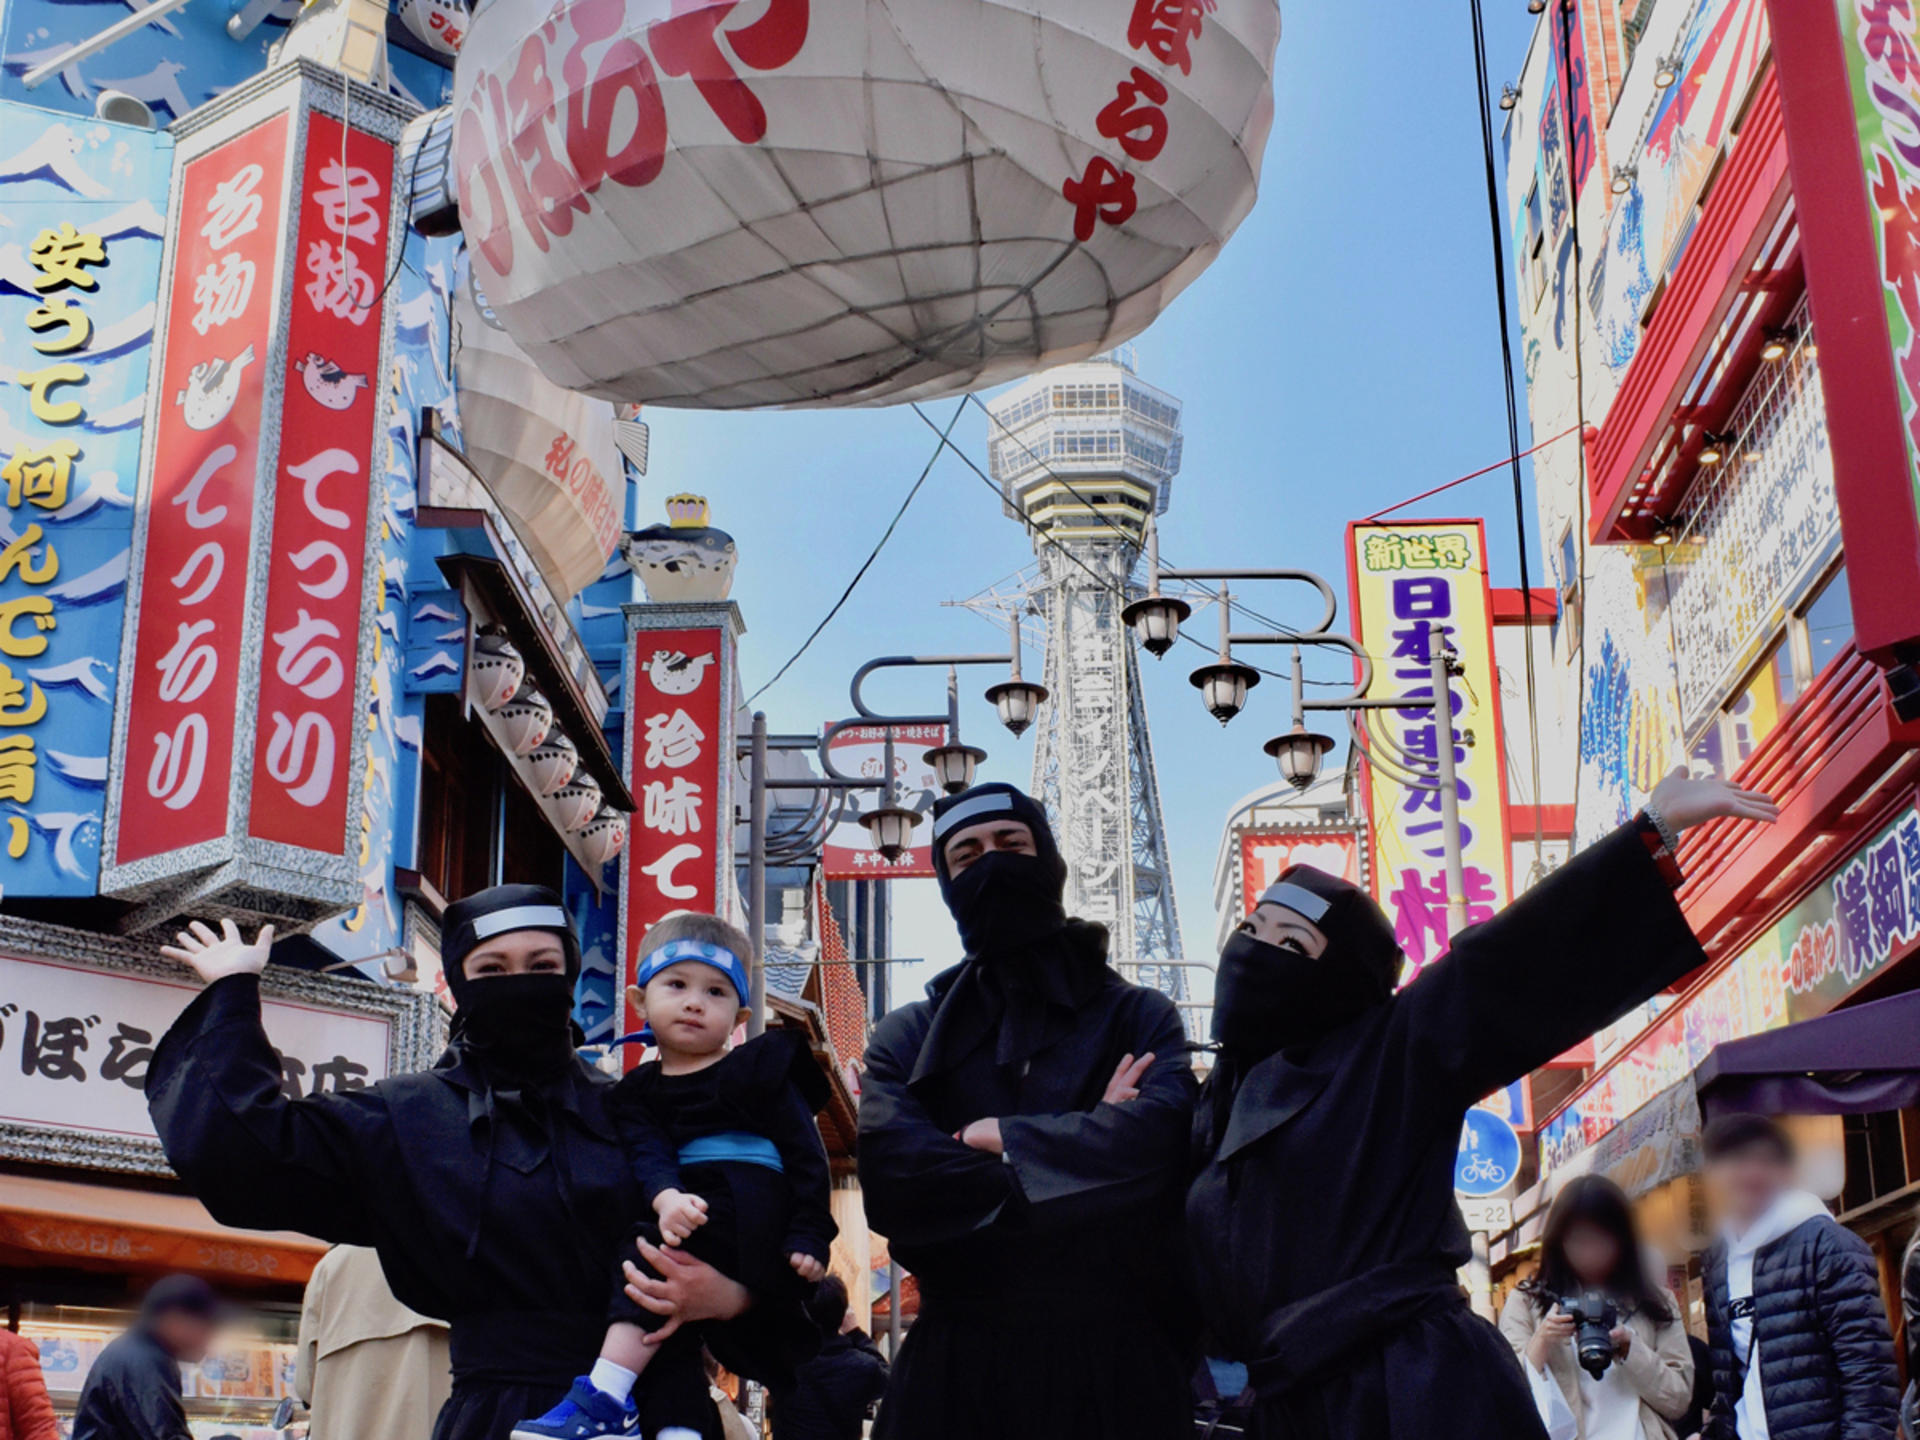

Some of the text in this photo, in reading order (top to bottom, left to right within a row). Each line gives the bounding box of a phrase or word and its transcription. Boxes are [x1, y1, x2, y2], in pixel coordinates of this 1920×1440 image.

[1363, 534, 1471, 571] 新世界
[641, 708, 705, 930] 珍味て
